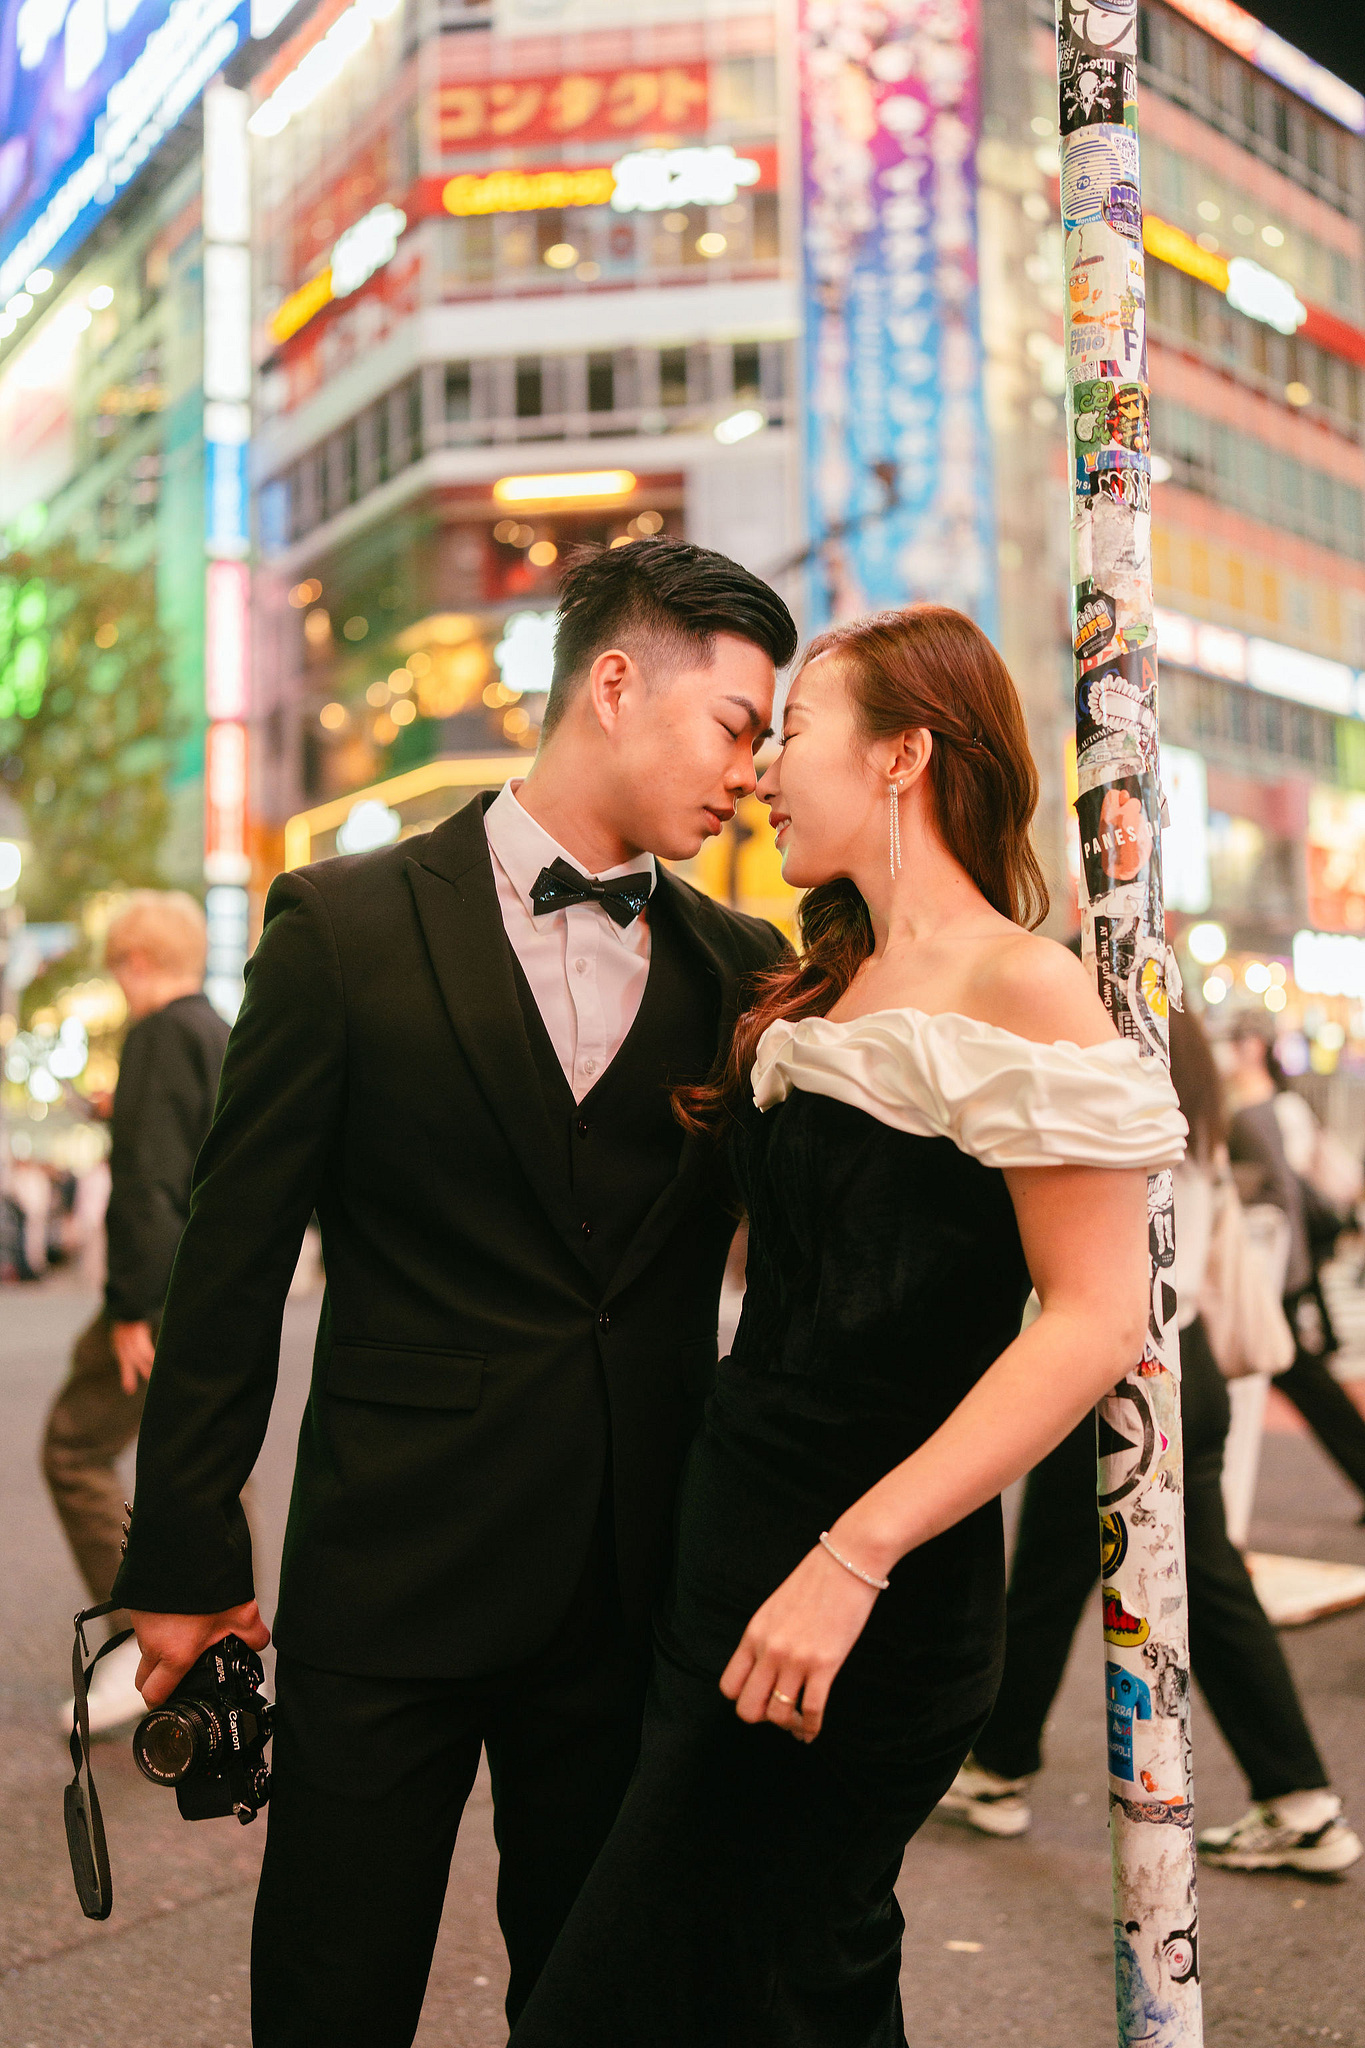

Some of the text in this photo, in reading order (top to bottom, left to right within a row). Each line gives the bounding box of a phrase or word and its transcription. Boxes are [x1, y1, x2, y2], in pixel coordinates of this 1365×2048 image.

[1077, 177, 1090, 188] 79
[1081, 726, 1116, 749] AUTOMA
[1084, 826, 1137, 859] PANES
[1099, 925, 1108, 937] AT
[1100, 940, 1109, 958] THE
[1102, 961, 1110, 980] GUY
[1103, 983, 1113, 1008] WHO
[228, 1710, 241, 1751] Canon
